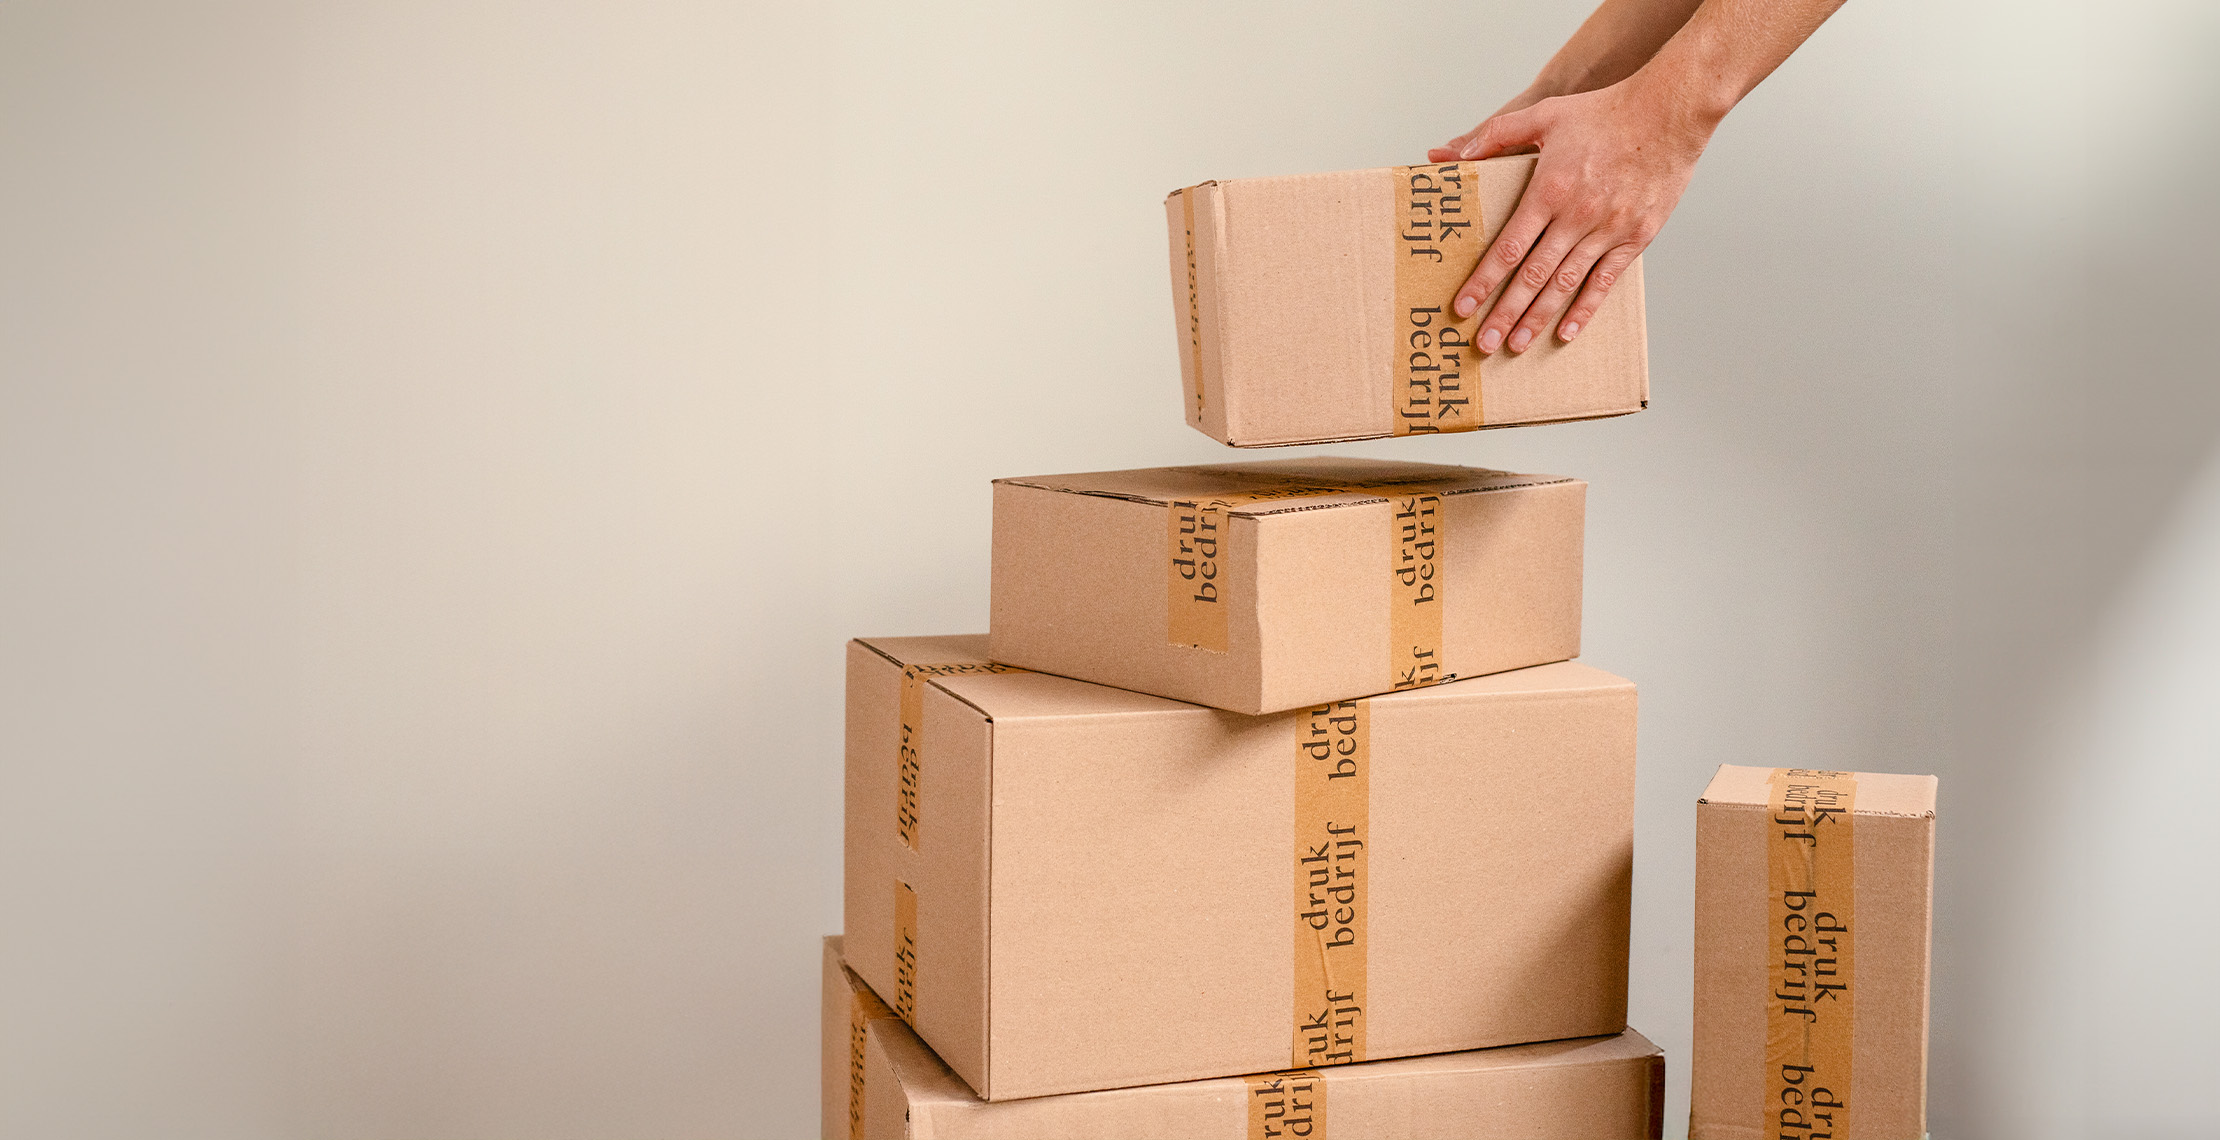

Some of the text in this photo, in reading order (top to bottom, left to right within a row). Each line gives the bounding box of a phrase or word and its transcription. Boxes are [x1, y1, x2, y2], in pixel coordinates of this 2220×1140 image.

[1402, 167, 1442, 264] drijf
[1401, 305, 1441, 434] bedrijf
[1438, 327, 1470, 419] druk
[1396, 497, 1417, 586] druk
[1302, 703, 1331, 760] dru
[1328, 699, 1357, 781] bedr
[899, 723, 913, 849] bedrijf
[909, 748, 919, 832] druk
[1301, 841, 1329, 930] druk
[1326, 821, 1363, 950] bedrijf
[1775, 890, 1817, 1023] bedrijf
[1814, 912, 1848, 1003] druk
[1255, 1078, 1286, 1139] ruk
